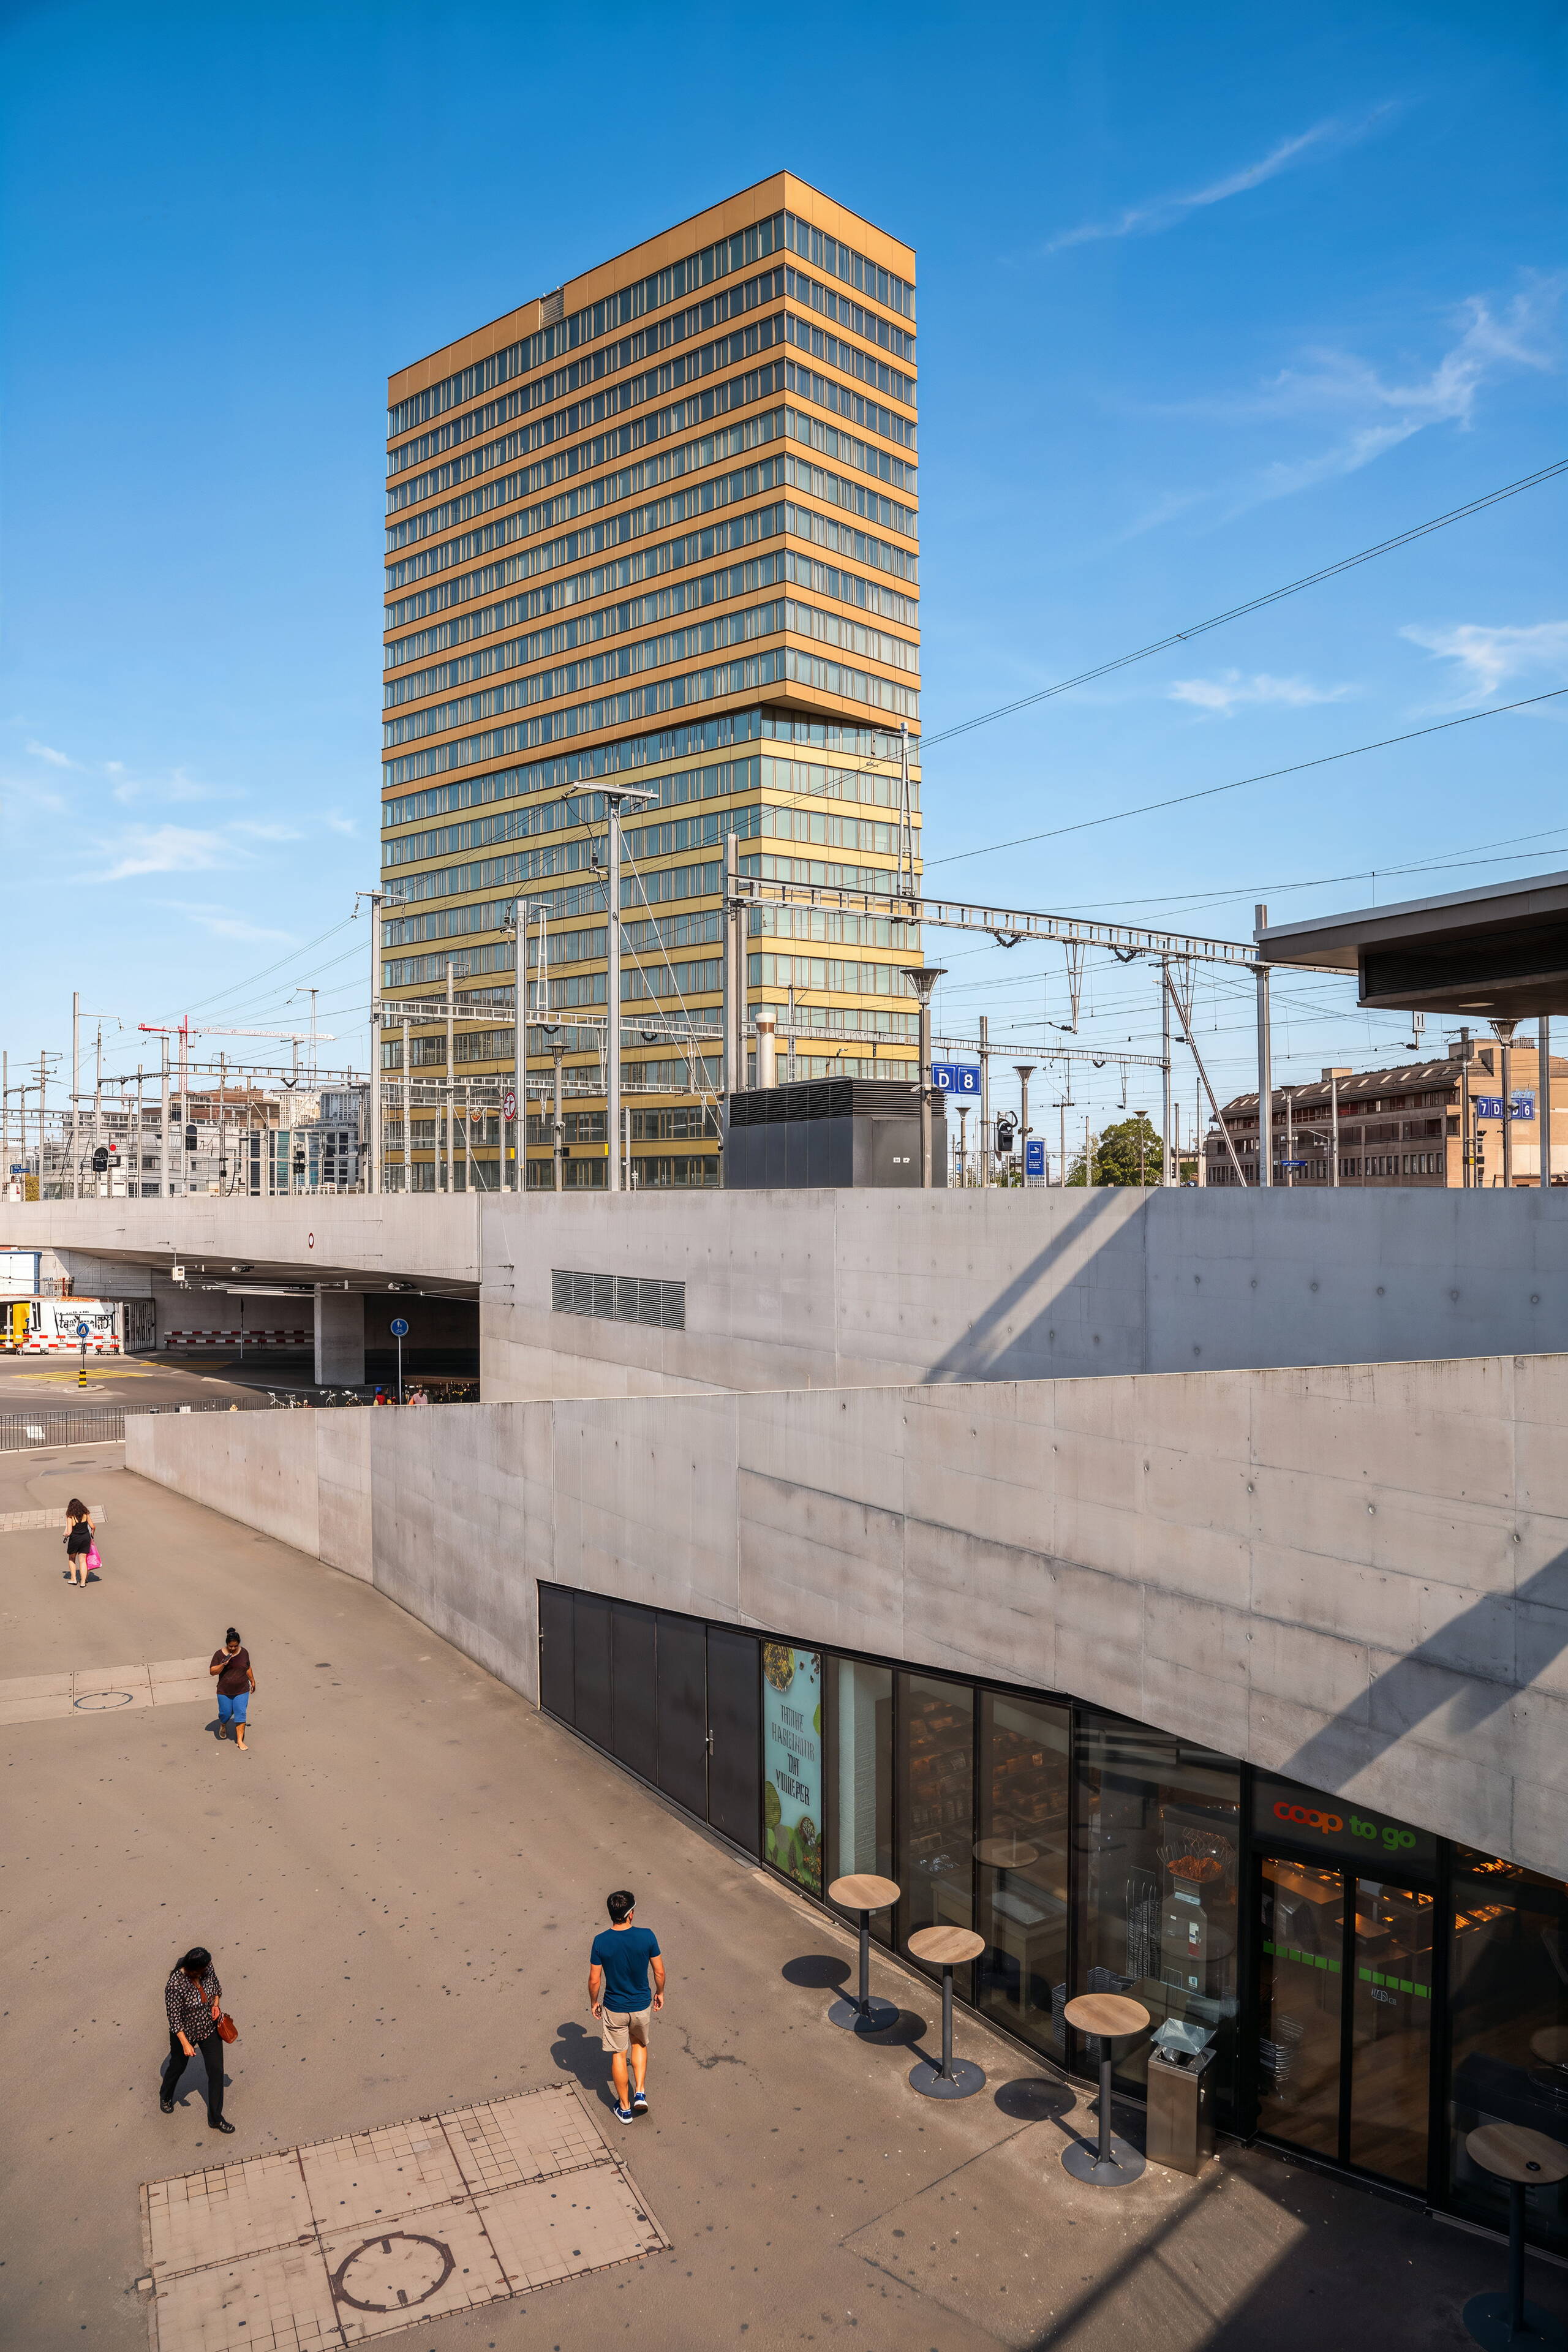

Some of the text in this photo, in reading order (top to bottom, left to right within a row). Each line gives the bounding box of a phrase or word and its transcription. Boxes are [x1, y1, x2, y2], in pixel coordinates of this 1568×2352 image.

[938, 1072, 973, 1088] D 8
[1481, 1103, 1487, 1114] 7
[1494, 1104, 1500, 1115] D
[1525, 1105, 1530, 1116] 6
[1273, 1801, 1417, 1851] coop to go
